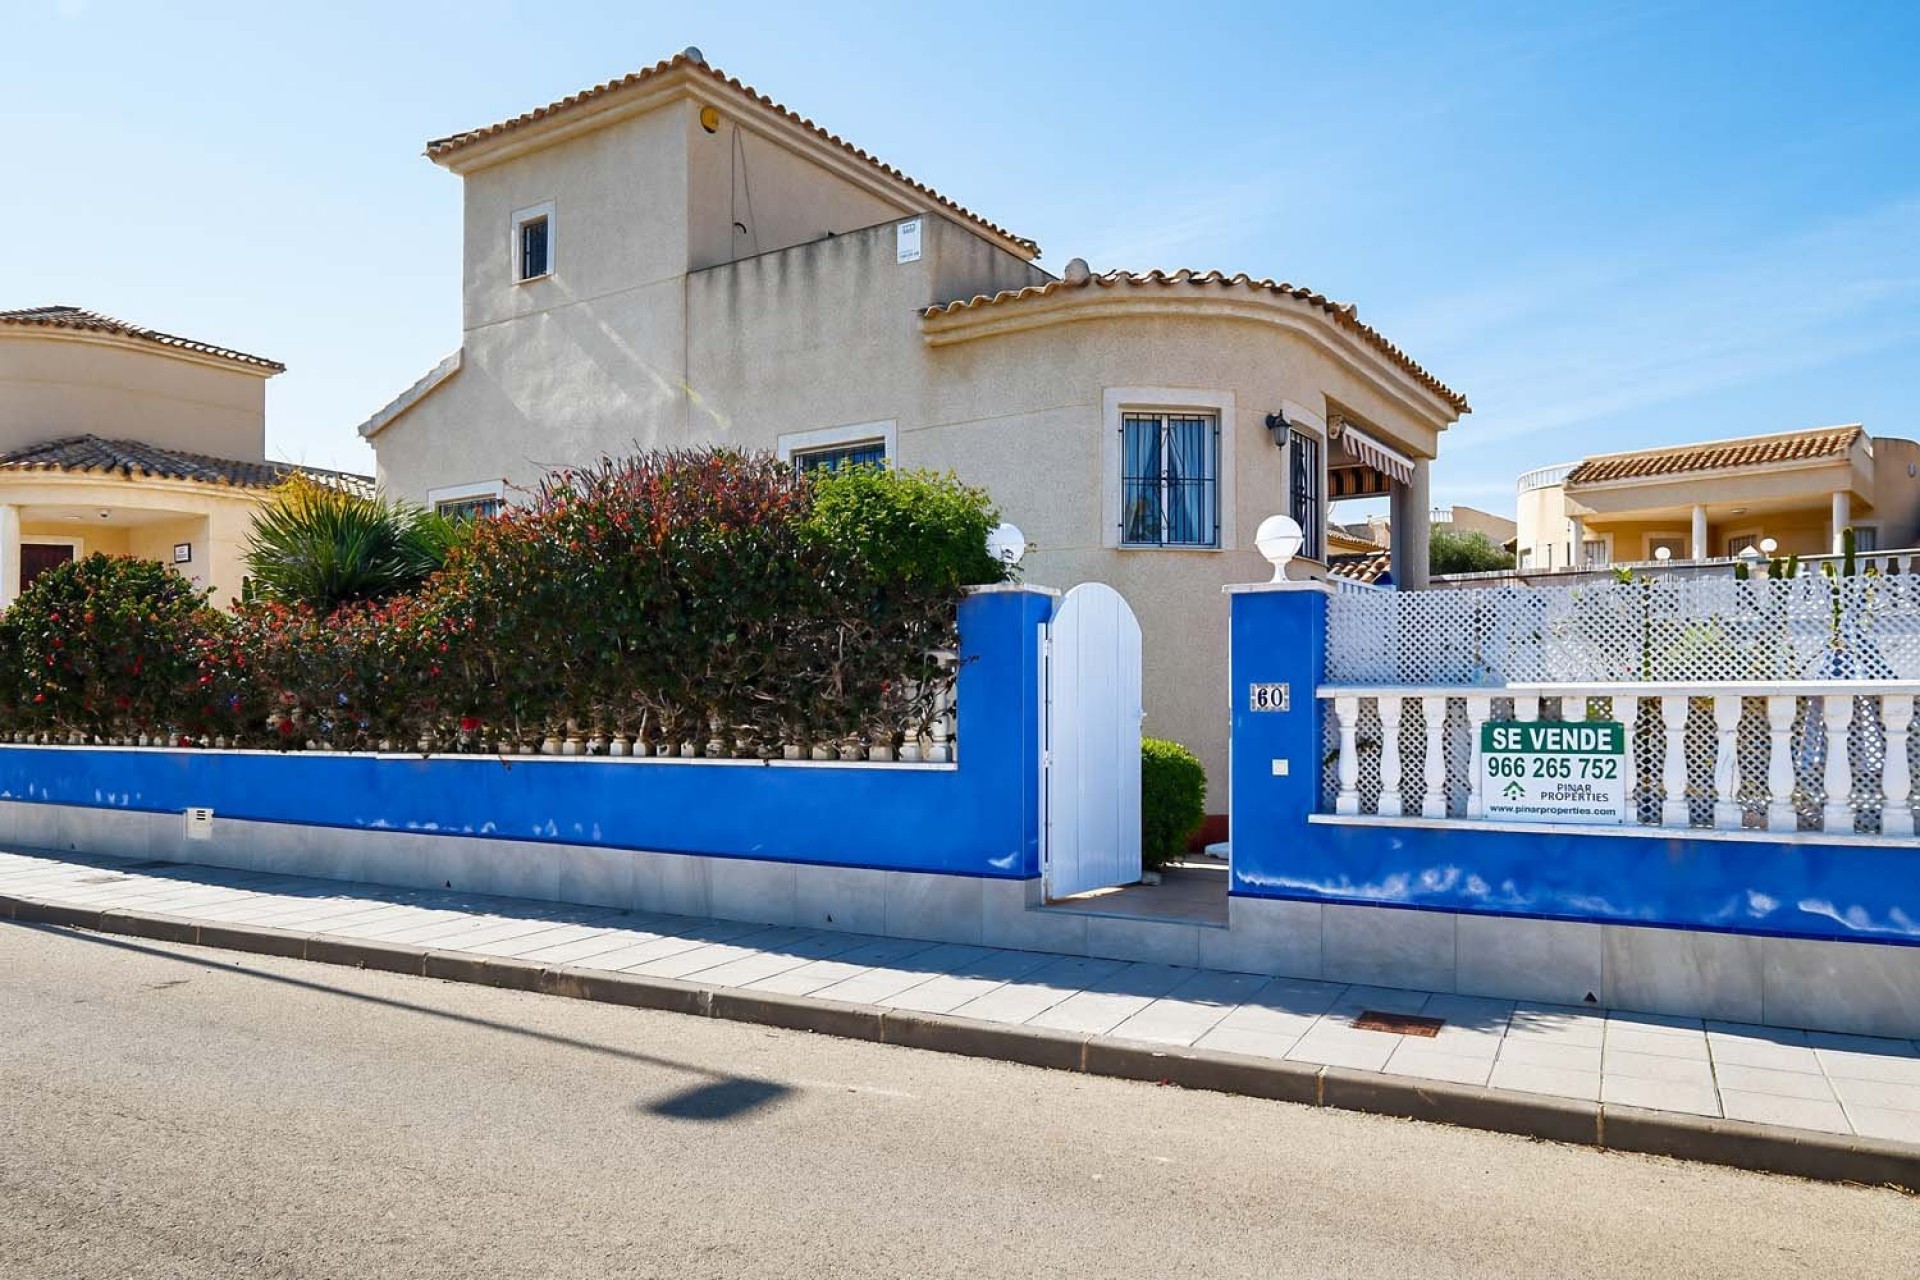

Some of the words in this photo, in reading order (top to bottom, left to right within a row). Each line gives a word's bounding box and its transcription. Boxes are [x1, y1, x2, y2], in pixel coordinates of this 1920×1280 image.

[1257, 687, 1283, 708] 60
[1492, 727, 1522, 750] SE
[1529, 728, 1613, 751] VENDE
[1488, 756, 1526, 778] 966
[1532, 757, 1571, 779] 265
[1578, 758, 1617, 779] 752
[1557, 783, 1592, 793] PINAR
[1540, 791, 1609, 802] PROPERTIES
[1489, 804, 1616, 816] www.pinarproperties.com
